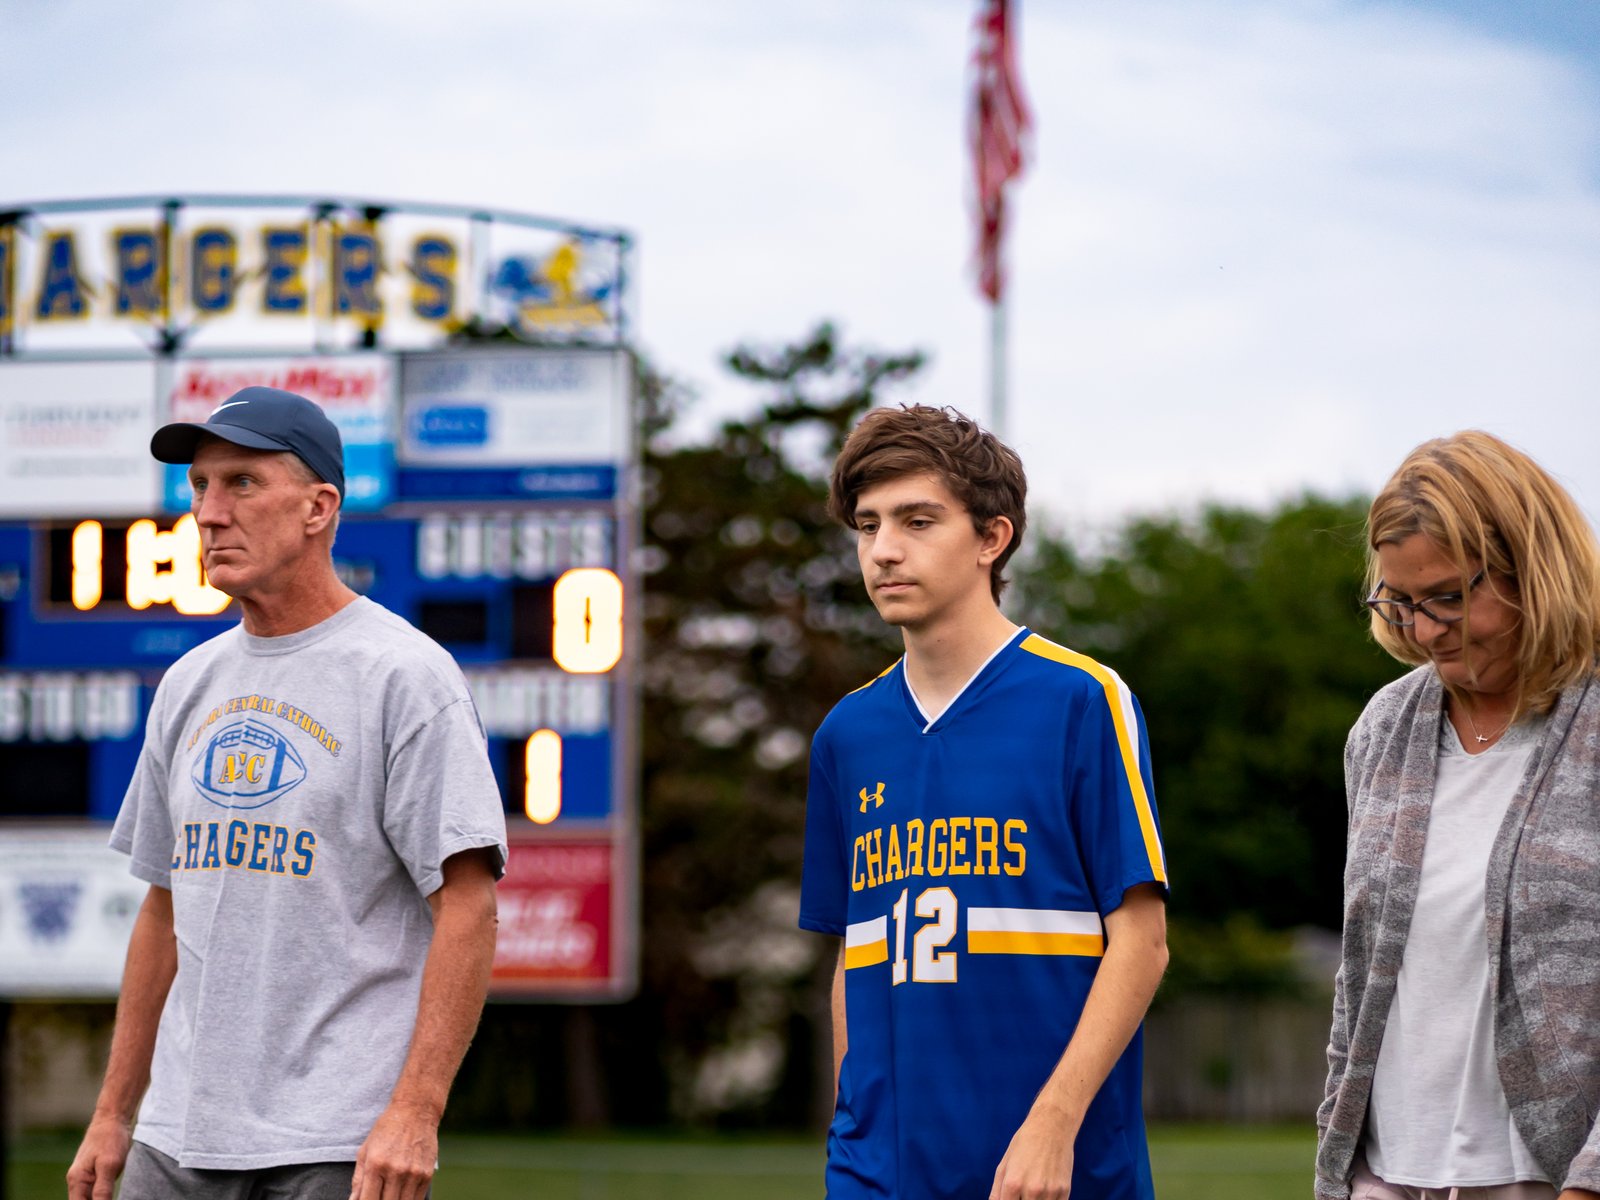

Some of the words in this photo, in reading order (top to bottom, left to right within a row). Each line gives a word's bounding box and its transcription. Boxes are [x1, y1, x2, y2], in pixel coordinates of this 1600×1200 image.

[0, 222, 457, 331] ARGERS
[552, 567, 624, 673] 0
[276, 701, 342, 757] CATHOLIC
[524, 728, 562, 825] 1
[851, 816, 1028, 893] CHARGERS
[892, 886, 958, 987] 12
